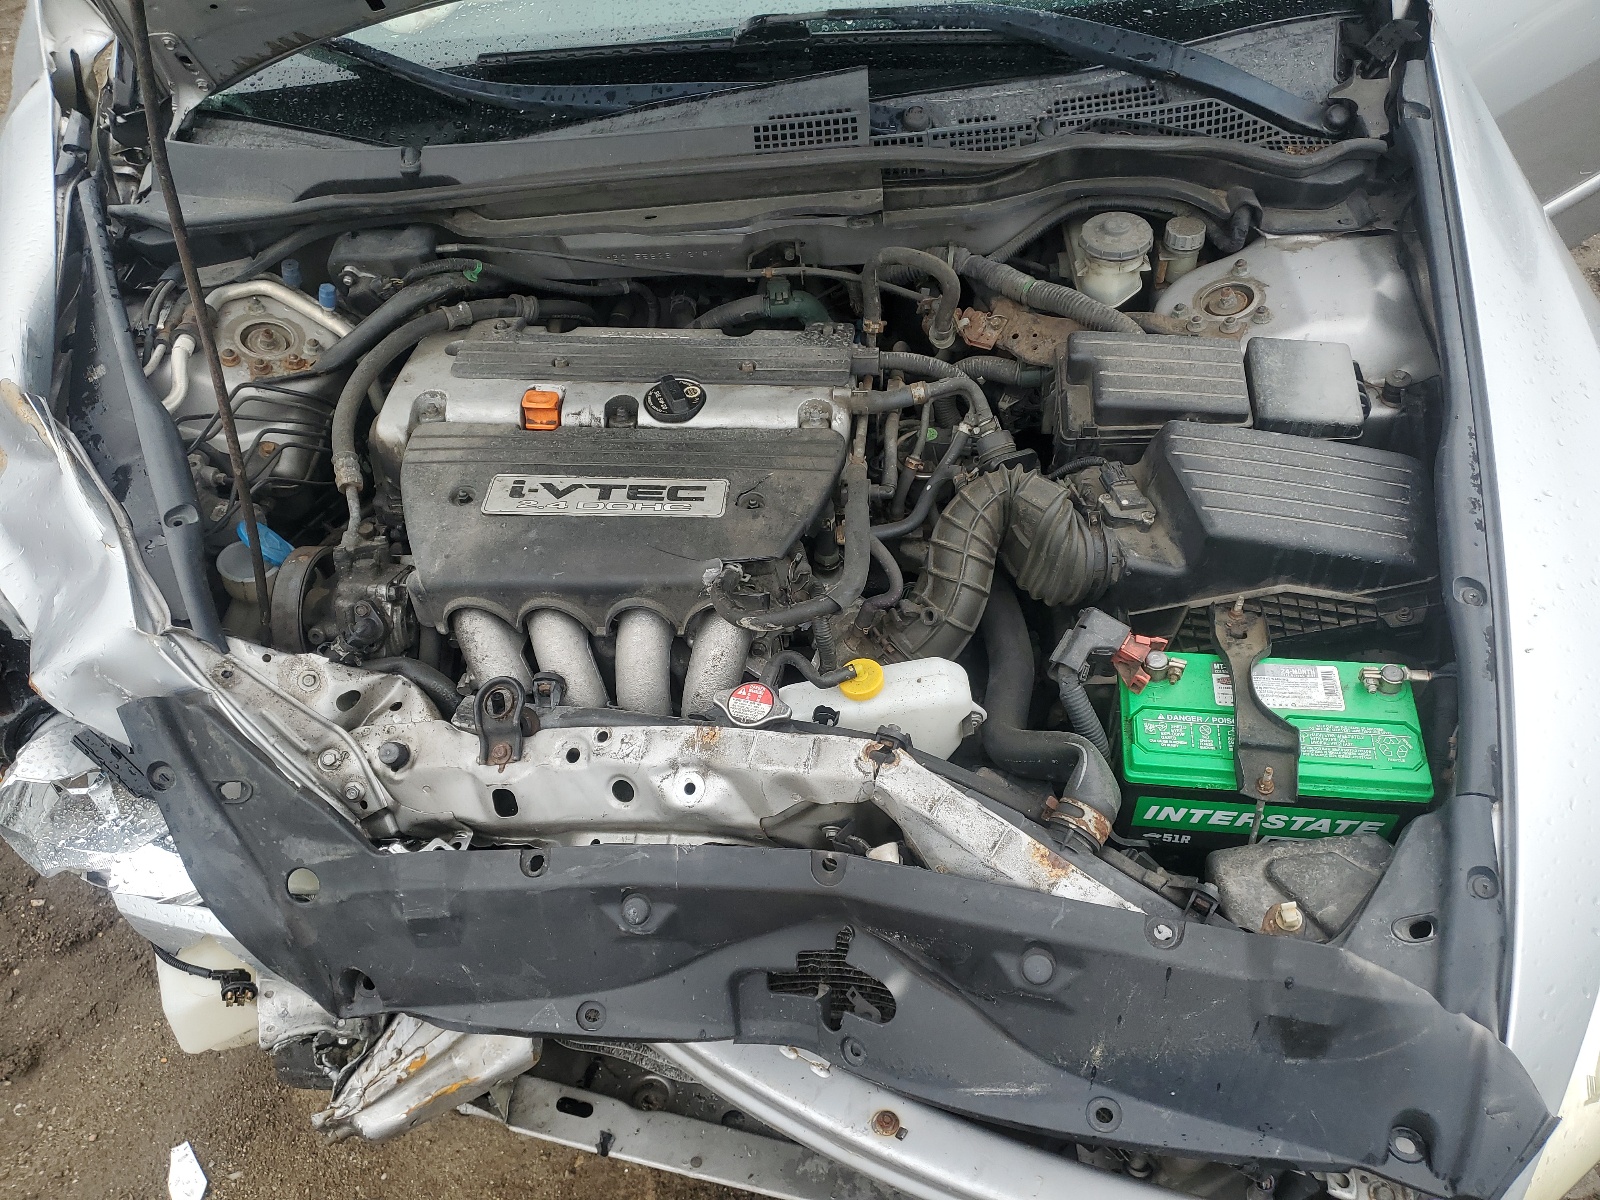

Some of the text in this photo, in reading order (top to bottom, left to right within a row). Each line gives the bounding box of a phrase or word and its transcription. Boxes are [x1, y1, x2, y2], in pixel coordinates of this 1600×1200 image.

[509, 480, 707, 502] i-VTEC
[516, 500, 692, 511] 2.4 DOHC
[1166, 714, 1203, 723] DANGER
[1143, 805, 1386, 835] INTERSTATE
[1162, 833, 1191, 844] 51R
